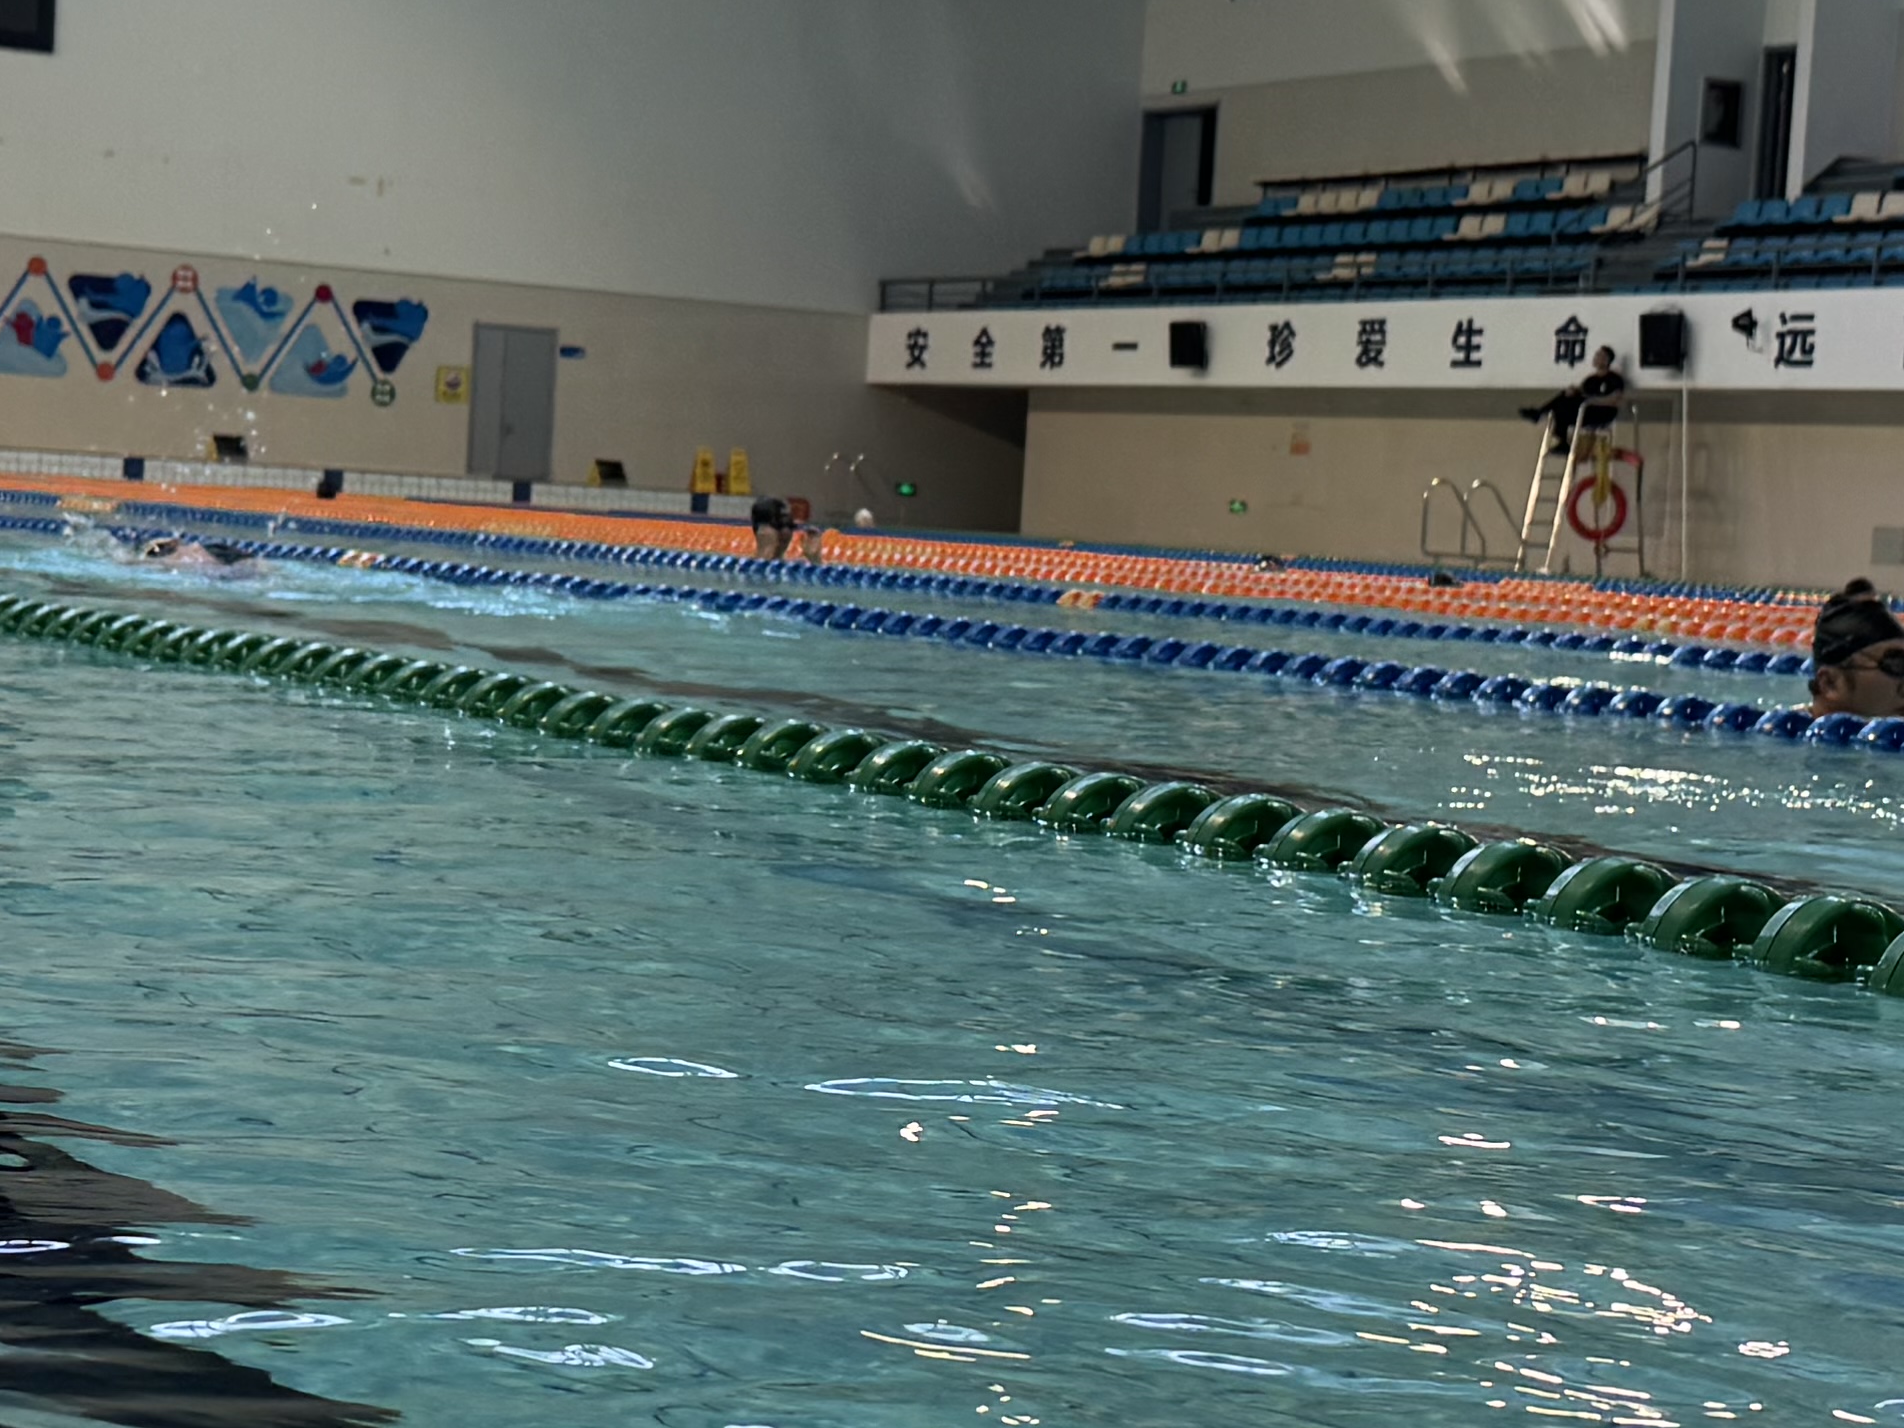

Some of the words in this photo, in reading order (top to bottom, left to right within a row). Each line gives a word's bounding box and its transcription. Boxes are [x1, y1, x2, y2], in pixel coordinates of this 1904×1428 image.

[905, 324, 1140, 370] 安全第一
[1265, 315, 1589, 369] 珍爱生命
